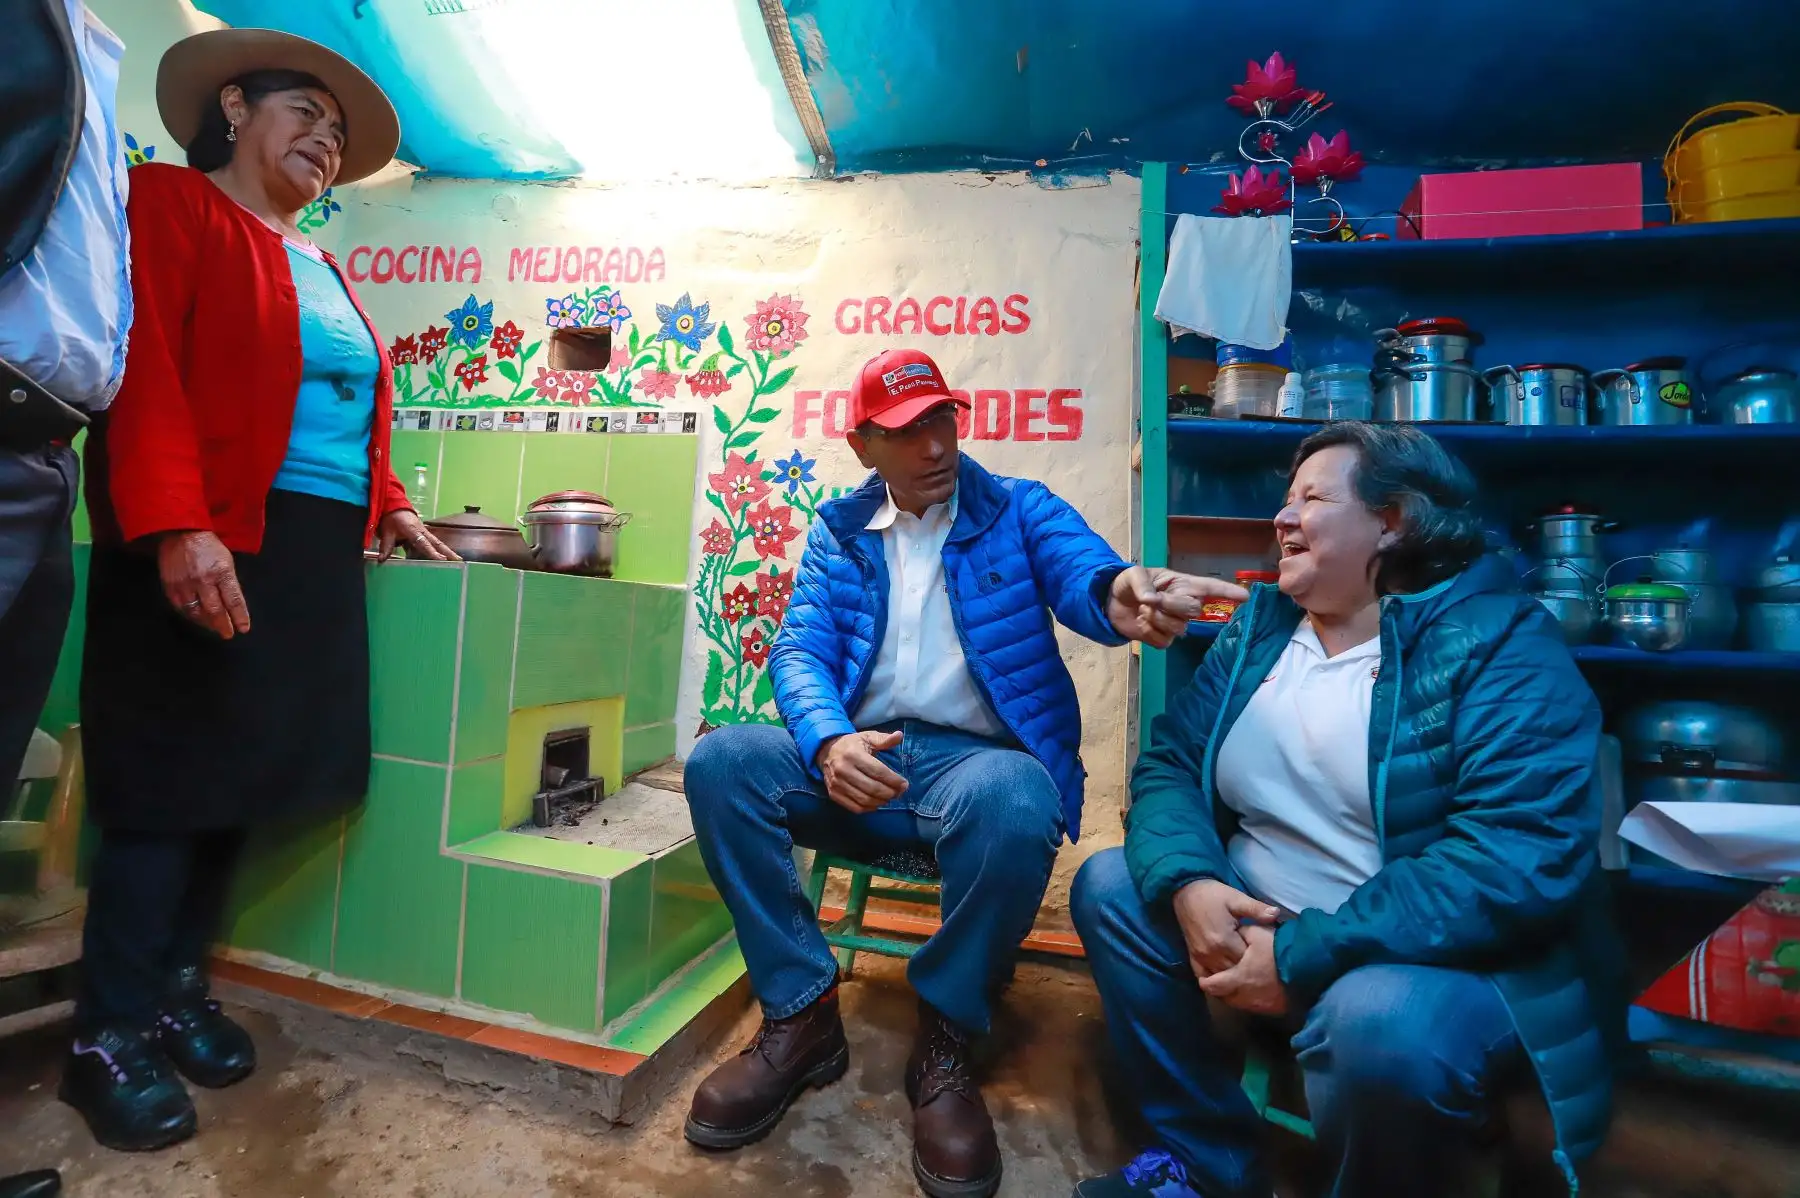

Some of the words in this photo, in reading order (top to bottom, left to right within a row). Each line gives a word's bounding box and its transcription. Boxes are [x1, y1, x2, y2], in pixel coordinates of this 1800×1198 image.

[346, 244, 482, 284] COCINA
[508, 246, 666, 283] MEJORADA
[834, 293, 1031, 336] GRACIAS
[792, 388, 1084, 442] FODES
